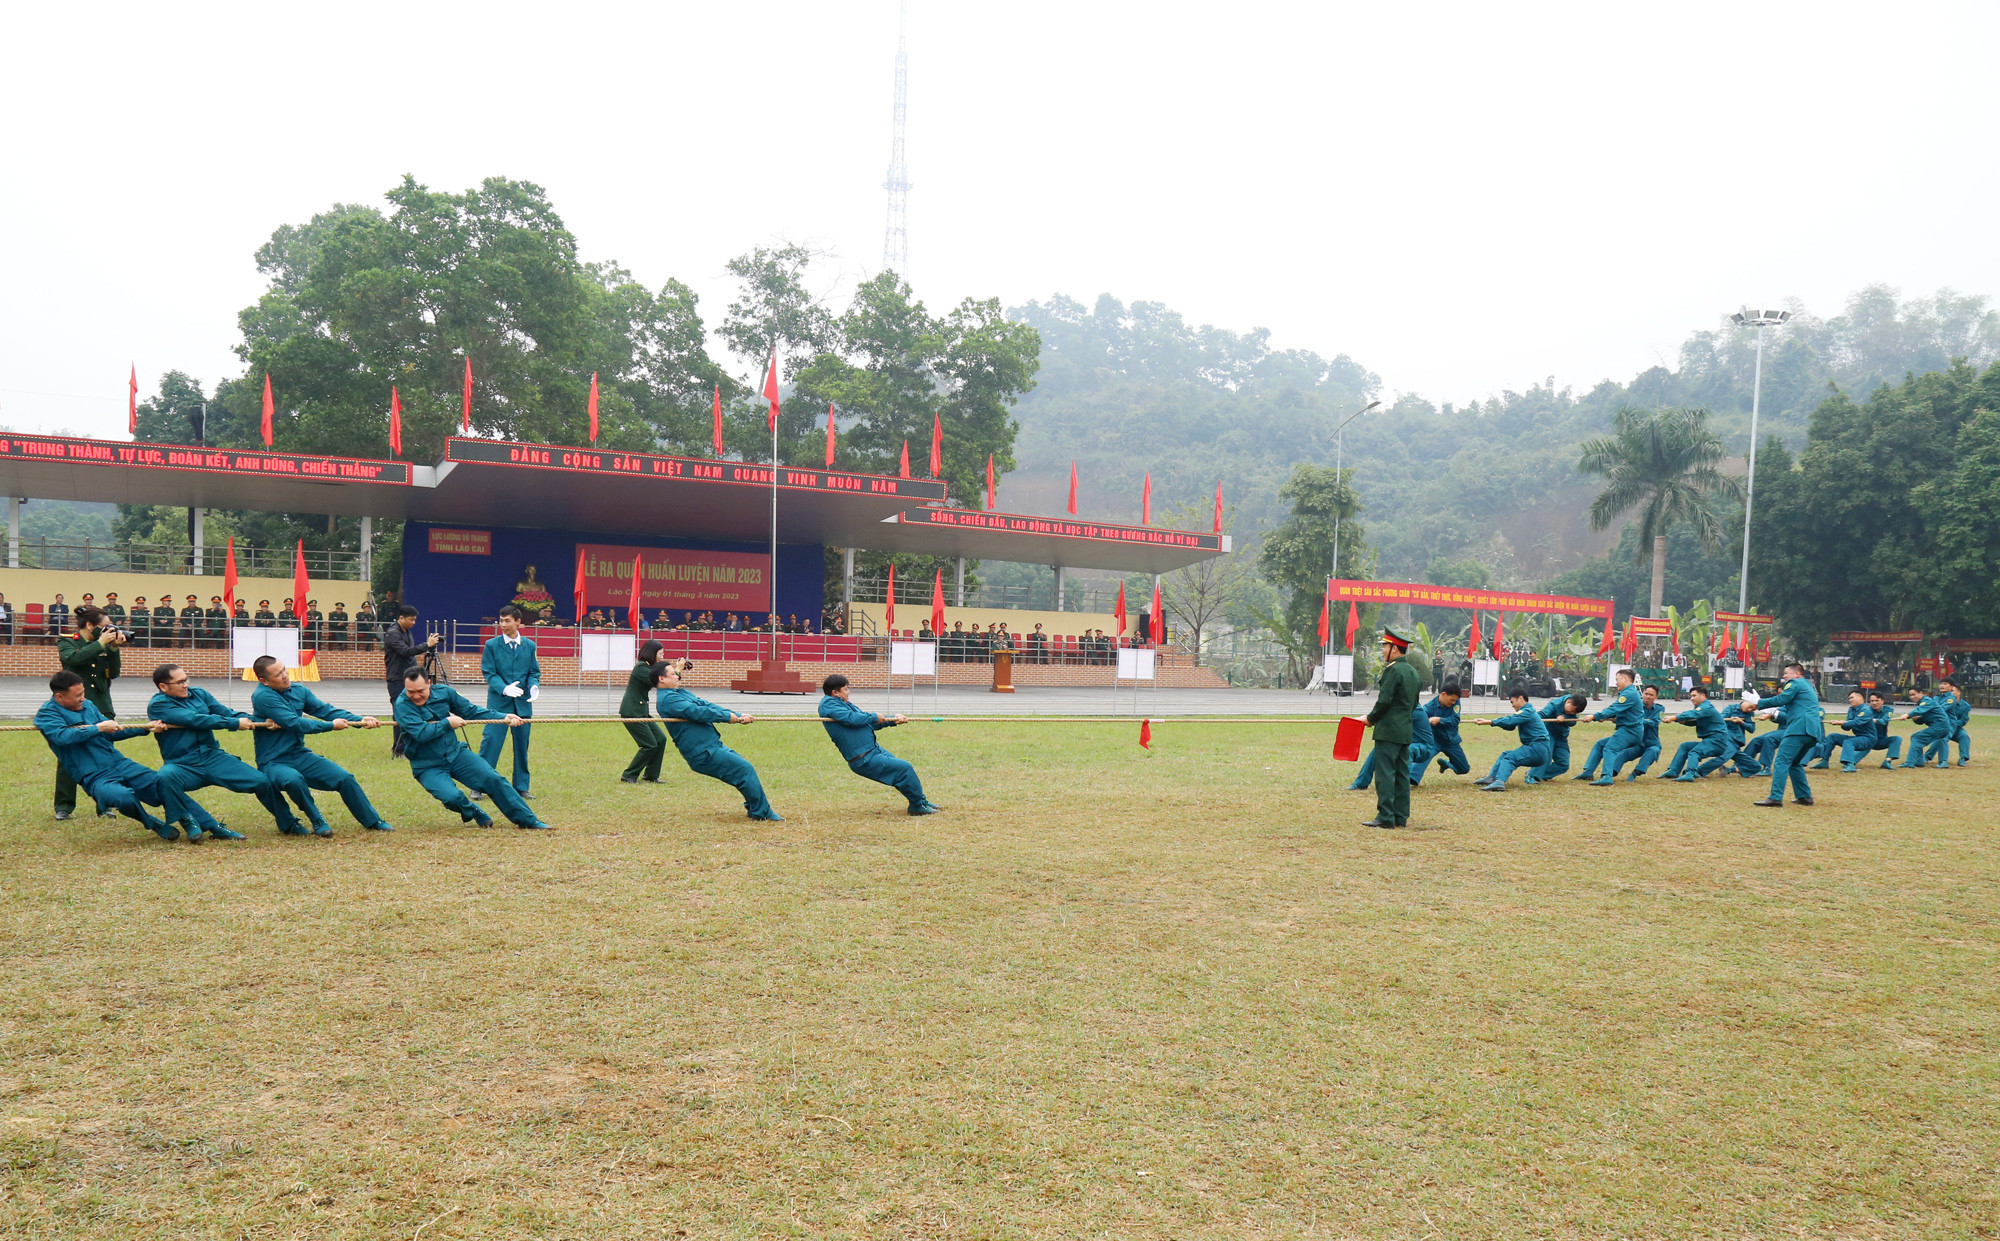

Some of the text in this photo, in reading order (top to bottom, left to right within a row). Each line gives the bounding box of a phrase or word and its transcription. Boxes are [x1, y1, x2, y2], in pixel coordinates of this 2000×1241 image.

[13, 441, 66, 456] "TRUNG
[68, 443, 115, 461] THÀNH,
[118, 448, 136, 464] TỰ
[138, 449, 166, 465] LỰC,
[169, 450, 202, 466] ĐOÀN
[206, 453, 232, 469] KẾT,
[235, 457, 260, 470] ANH
[263, 458, 299, 473] DŨNG,
[301, 460, 336, 475] CHIẾN
[340, 461, 383, 478] THẮNG"
[510, 447, 898, 493] ĐẢNG CỘNG SẢN VIỆT NAM QUANG VINH MUÔN NĂM
[930, 510, 1199, 547] SỐNG, CHIẾN ĐẤU, LAO ĐỘNG VÀ HỌC TẬP THEO GƯƠNG BÁC HỒ VĨ ĐẠI
[455, 543, 470, 552] LÀO
[471, 545, 485, 553] CAI
[584, 554, 597, 577] LỄ
[600, 560, 614, 578] RA
[648, 558, 676, 581] HUẤN
[678, 561, 710, 585] LUYỆN
[712, 563, 736, 584] NĂM
[738, 568, 762, 585] 2023
[607, 588, 623, 596] Lào
[642, 590, 660, 599] ngày
[674, 591, 696, 600] tháng
[703, 592, 720, 600] năm
[721, 592, 740, 600] 2023
